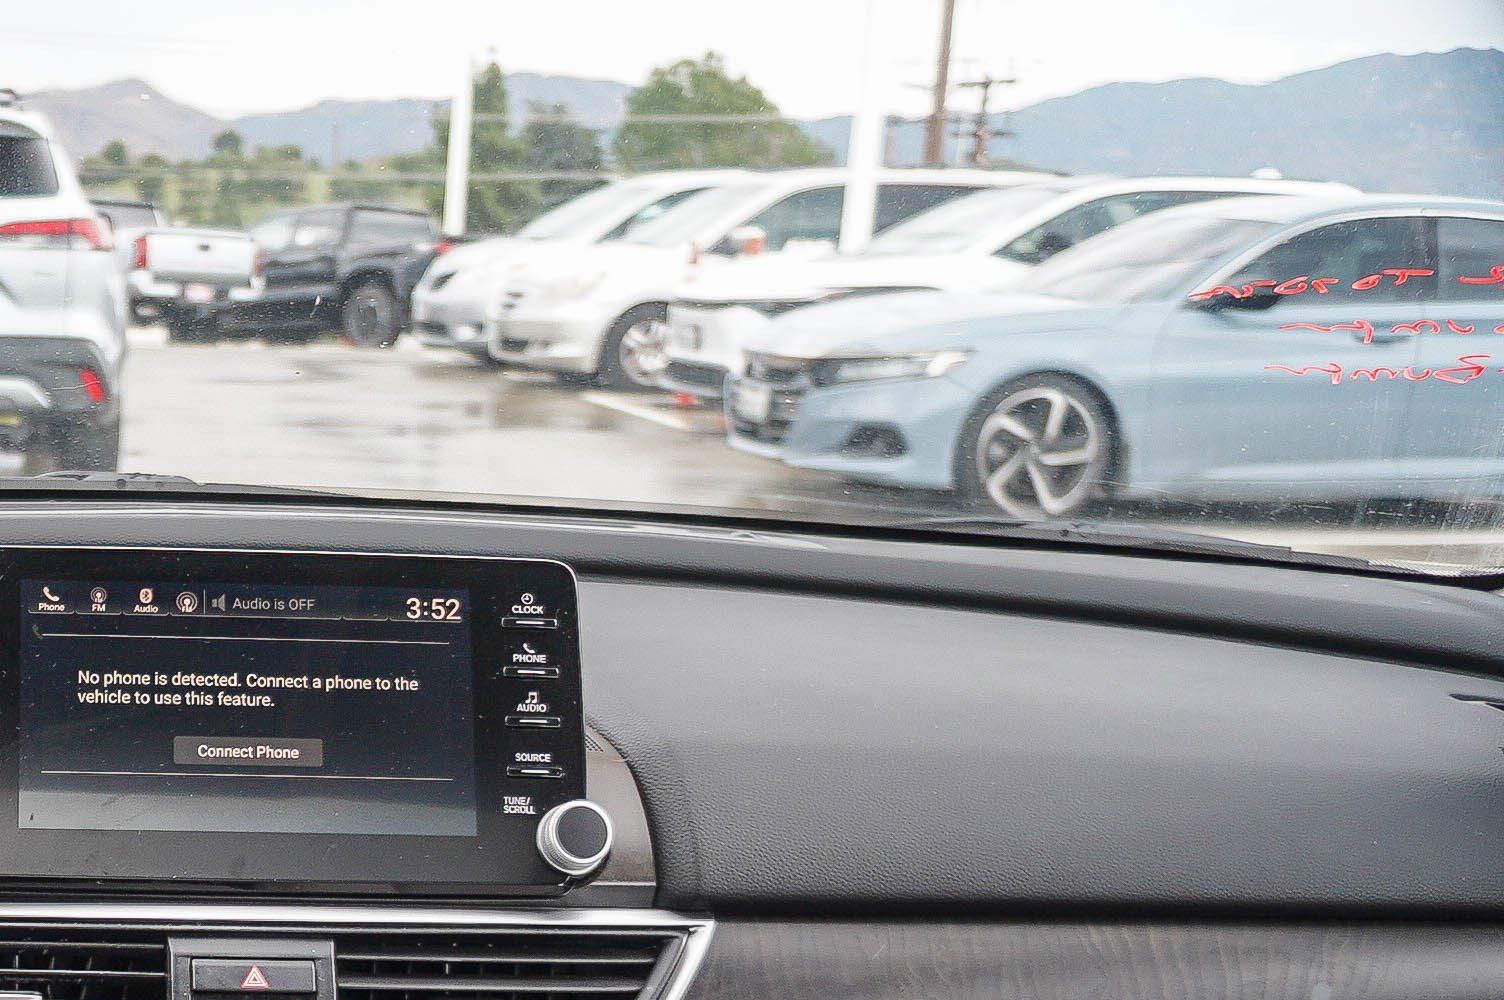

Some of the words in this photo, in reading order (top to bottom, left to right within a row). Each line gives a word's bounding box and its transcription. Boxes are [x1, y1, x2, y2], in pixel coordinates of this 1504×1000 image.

[38, 603, 65, 612] Phone
[91, 604, 106, 612] FM
[133, 604, 158, 613] Audio
[232, 598, 271, 610] Audio
[274, 598, 285, 610] is
[288, 599, 316, 611] OFF
[406, 598, 462, 620] 3:52
[511, 605, 544, 615] CLOCK
[512, 654, 547, 664] PHONE
[77, 670, 100, 685] No
[103, 671, 151, 687] phone
[154, 672, 168, 686] is
[171, 672, 242, 687] detected.
[246, 673, 308, 688] Connect
[312, 678, 322, 689] a
[325, 675, 372, 692] phone
[375, 677, 391, 691] to
[394, 676, 419, 691] the
[77, 689, 131, 704] vehicle
[134, 691, 151, 705] to
[154, 693, 182, 705] use
[185, 691, 214, 706] this
[217, 691, 275, 707] feature.
[516, 703, 547, 713] AUDIO
[197, 744, 254, 758] Connect
[256, 745, 300, 759] Phone
[515, 753, 552, 762] SOURCE
[503, 796, 531, 806] TUNE/
[503, 805, 537, 815] SCROLL
